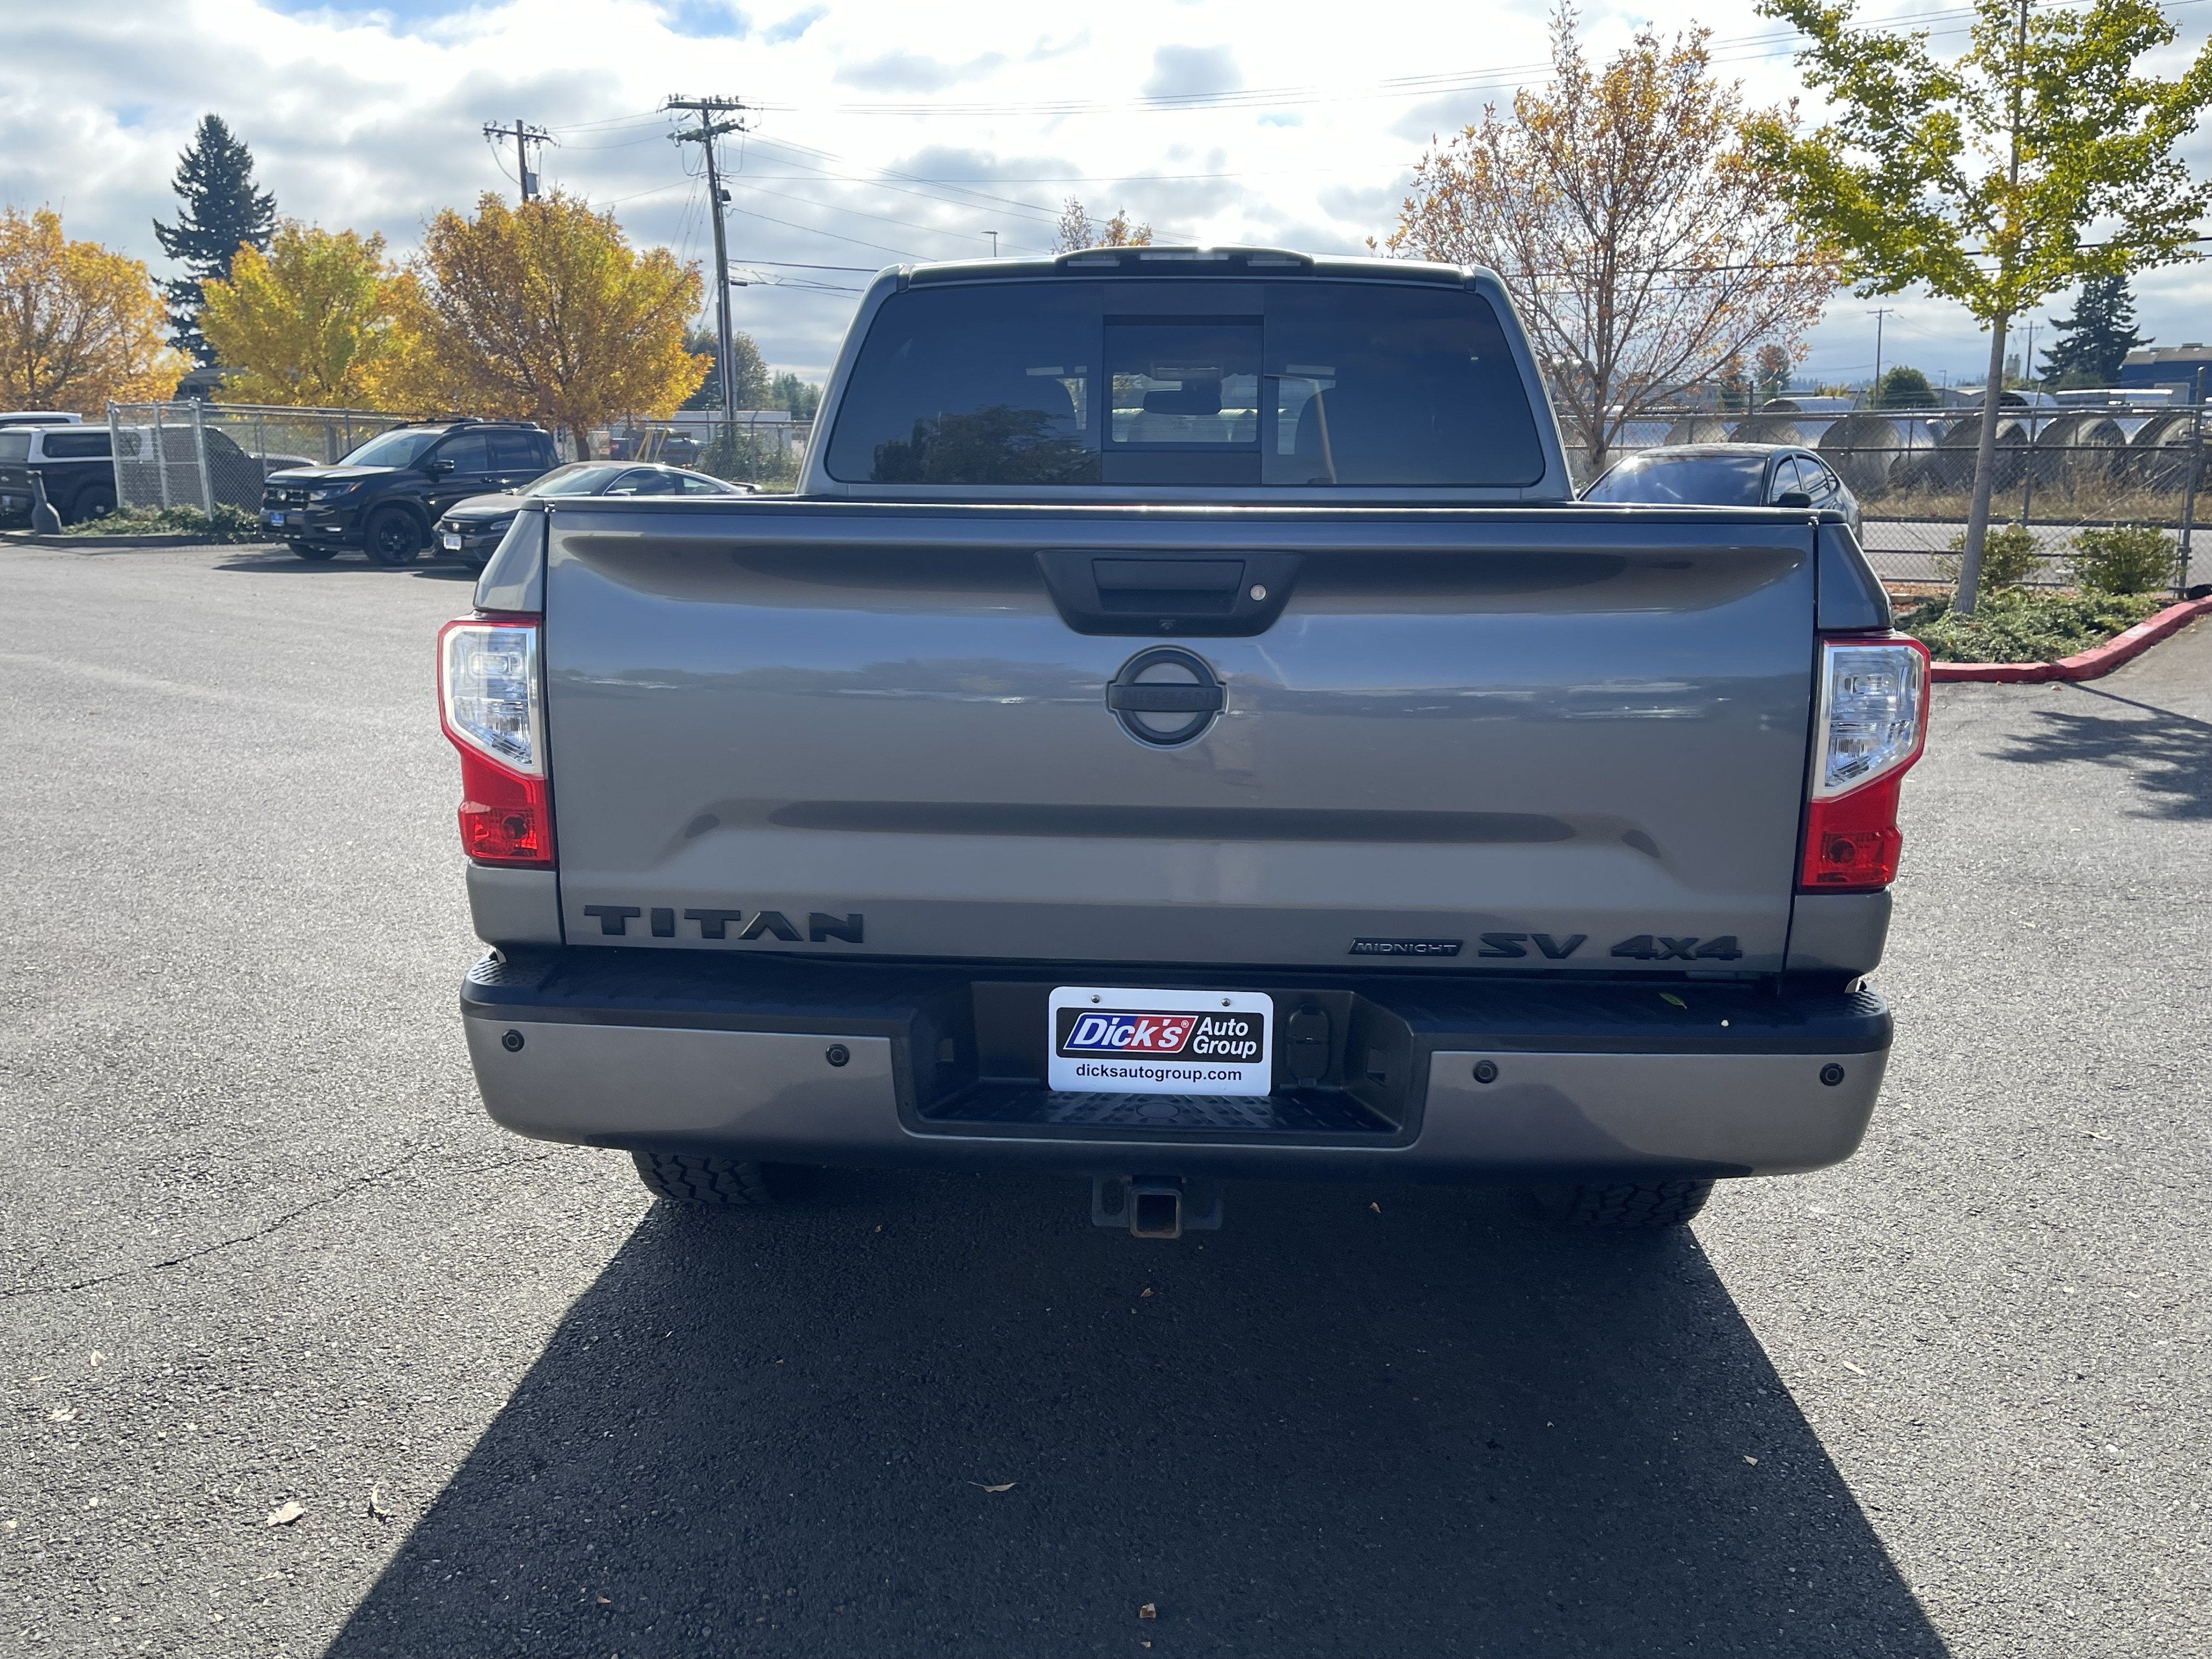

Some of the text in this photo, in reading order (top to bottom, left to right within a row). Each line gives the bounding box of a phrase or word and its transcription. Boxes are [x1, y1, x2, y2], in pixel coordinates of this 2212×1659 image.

[584, 905, 864, 943] TITAN
[1355, 942, 1458, 953] MIDNIGHT
[1478, 932, 1587, 959] SV
[1197, 1016, 1249, 1036] Auto
[1193, 1035, 1257, 1059] Group
[1076, 1063, 1243, 1082] dicksautogroup.com
